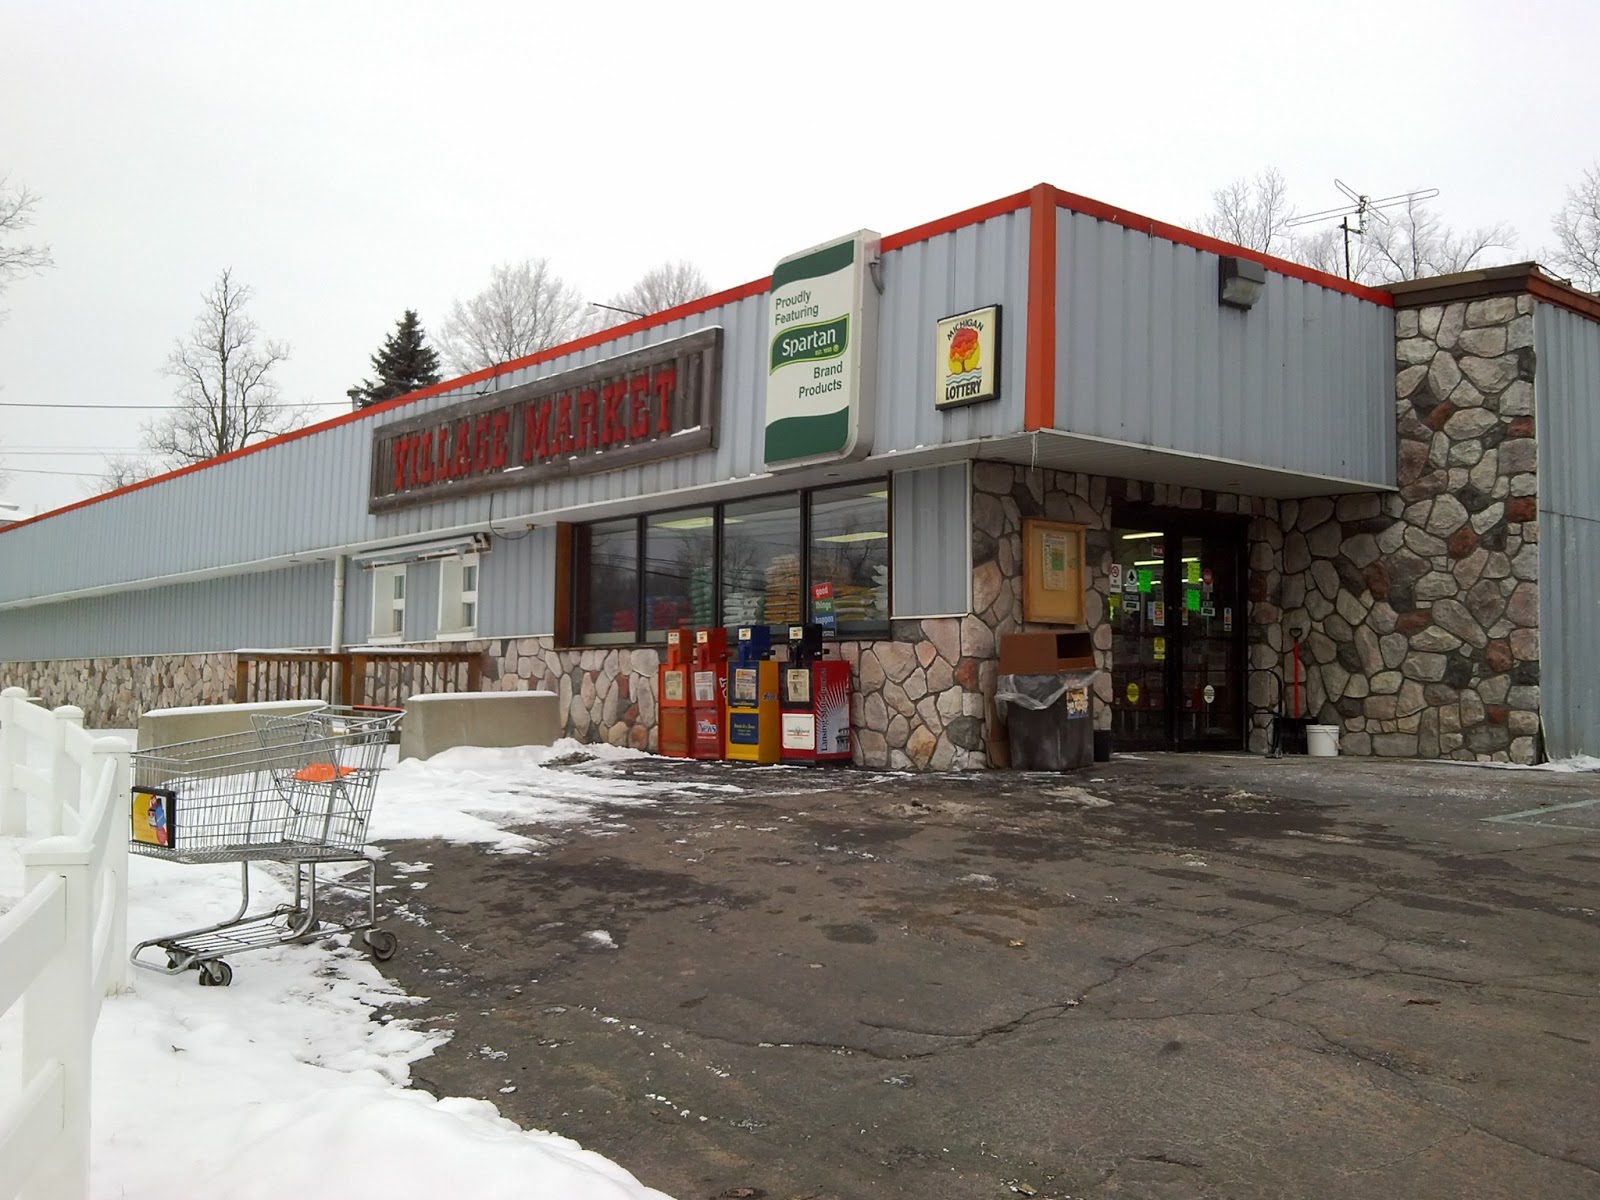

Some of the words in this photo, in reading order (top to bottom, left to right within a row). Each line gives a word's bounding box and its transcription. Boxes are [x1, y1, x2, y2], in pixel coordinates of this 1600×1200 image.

[775, 290, 811, 309] Proudly
[775, 305, 819, 325] Featuring
[946, 318, 984, 341] MICHIGAN
[781, 328, 836, 357] Spartan
[813, 361, 843, 379] Brand
[798, 379, 842, 398] Products
[945, 380, 982, 400] LOTTERY
[392, 411, 510, 490] VILLAGE
[523, 368, 677, 462] MARKET
[821, 720, 829, 751] Lansing
